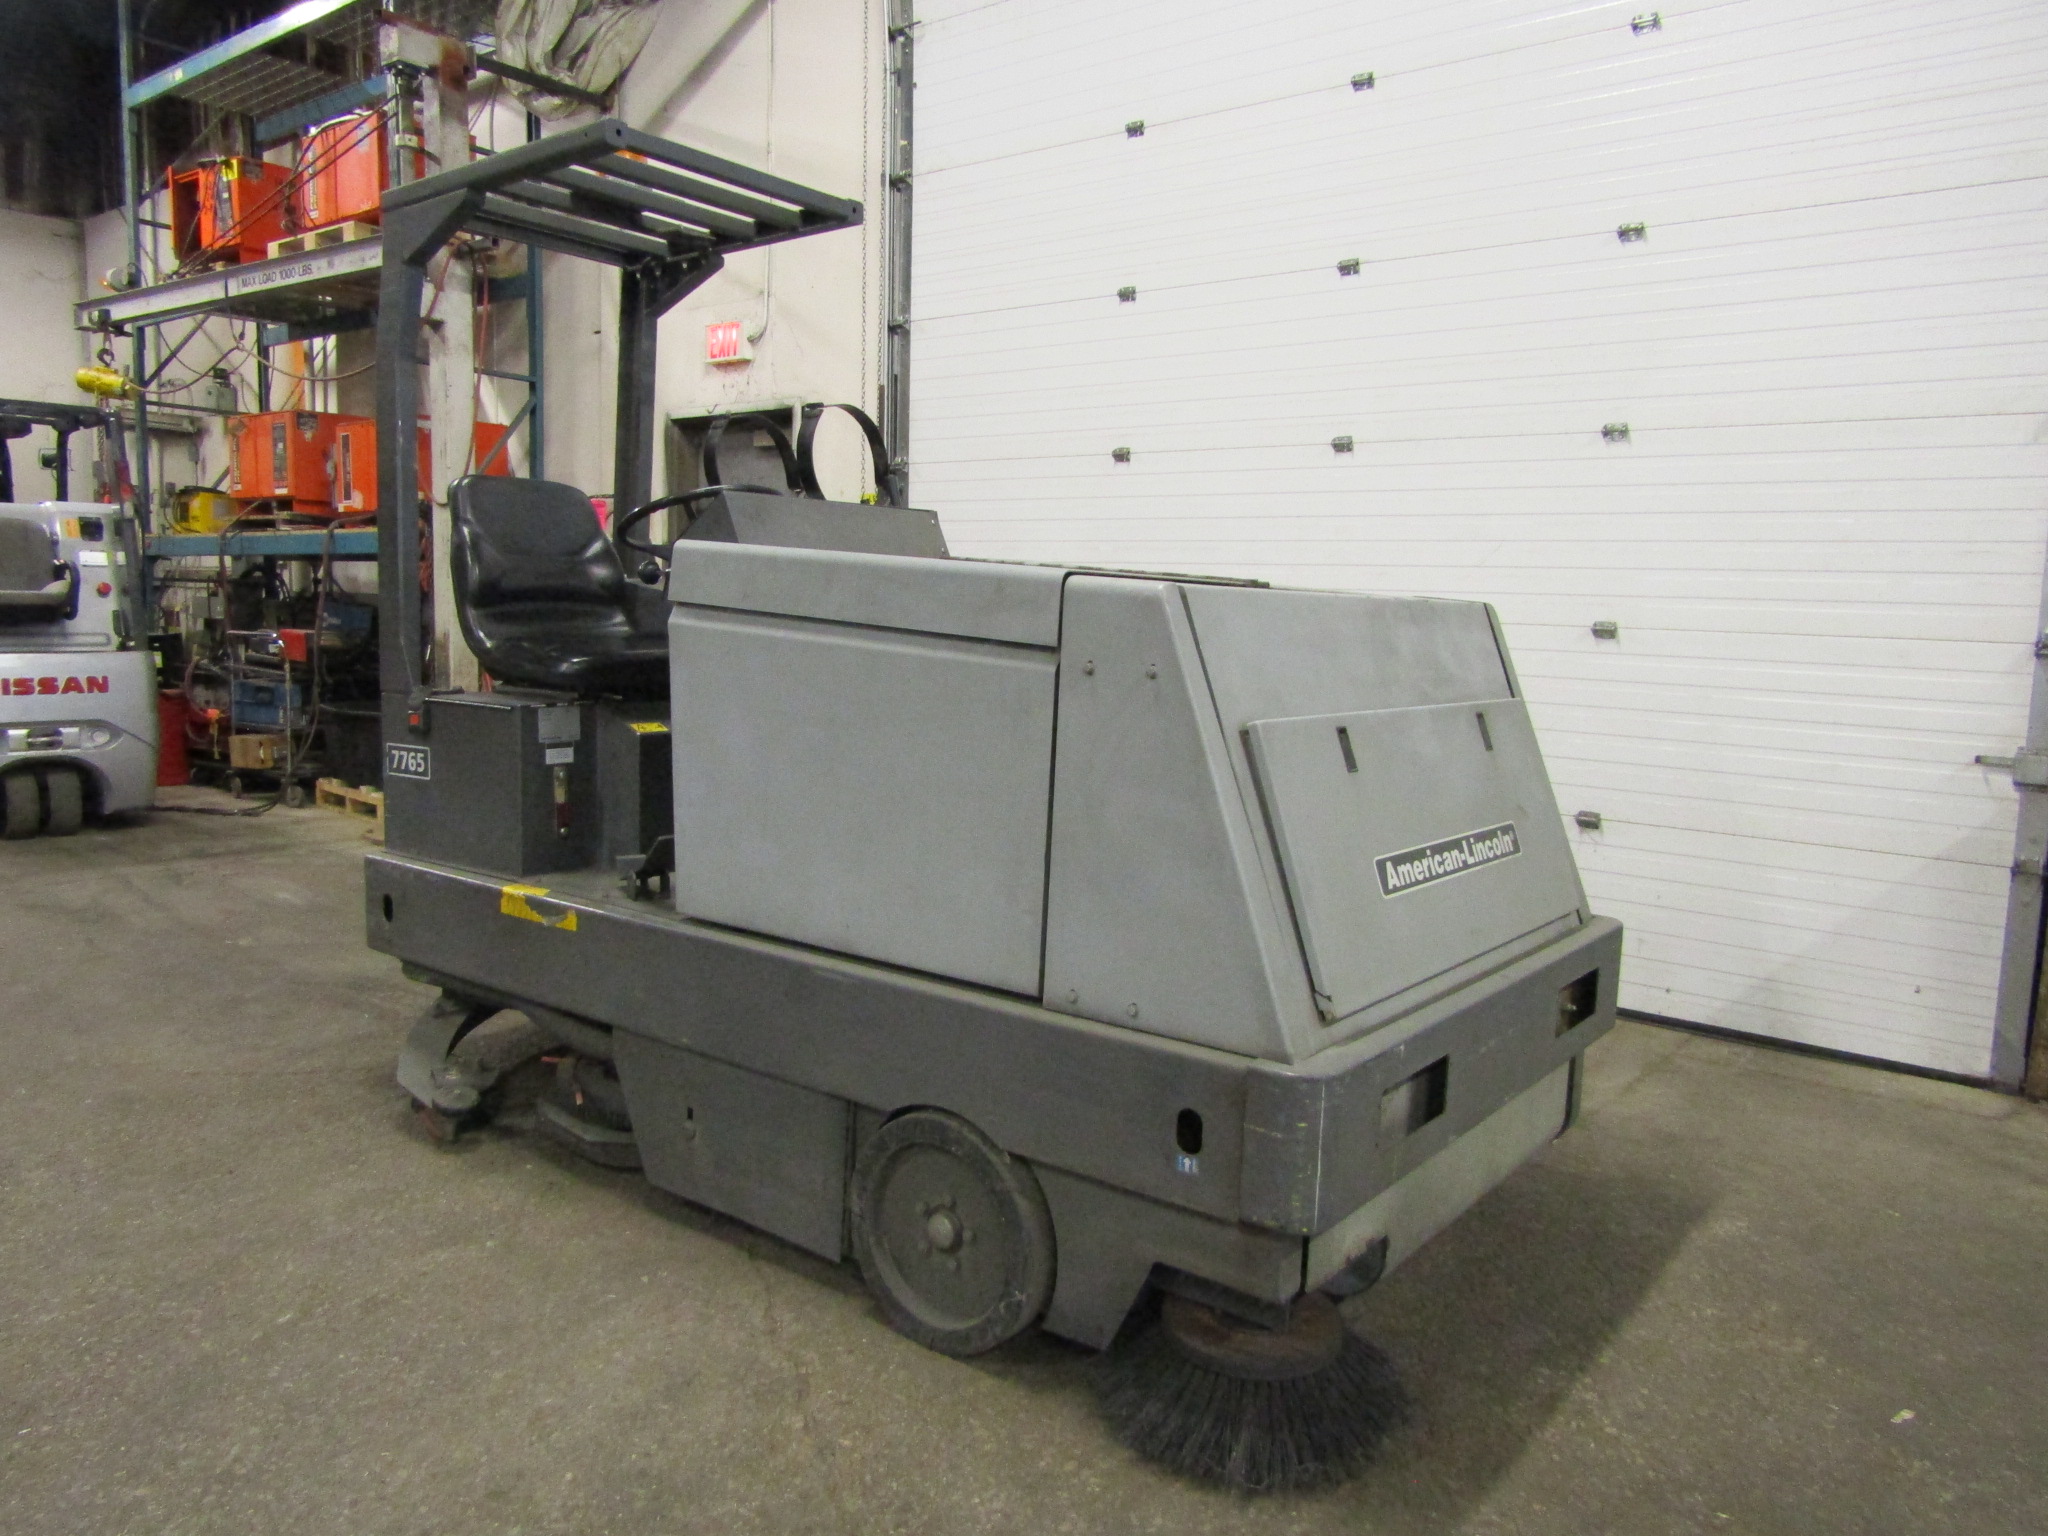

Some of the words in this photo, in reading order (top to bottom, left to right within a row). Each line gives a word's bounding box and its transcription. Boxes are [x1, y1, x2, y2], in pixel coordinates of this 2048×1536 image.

[241, 277, 257, 288] MAX
[258, 271, 277, 285] LOAD
[279, 267, 297, 281] 1000
[710, 322, 740, 359] EXIT
[391, 750, 425, 772] 7765
